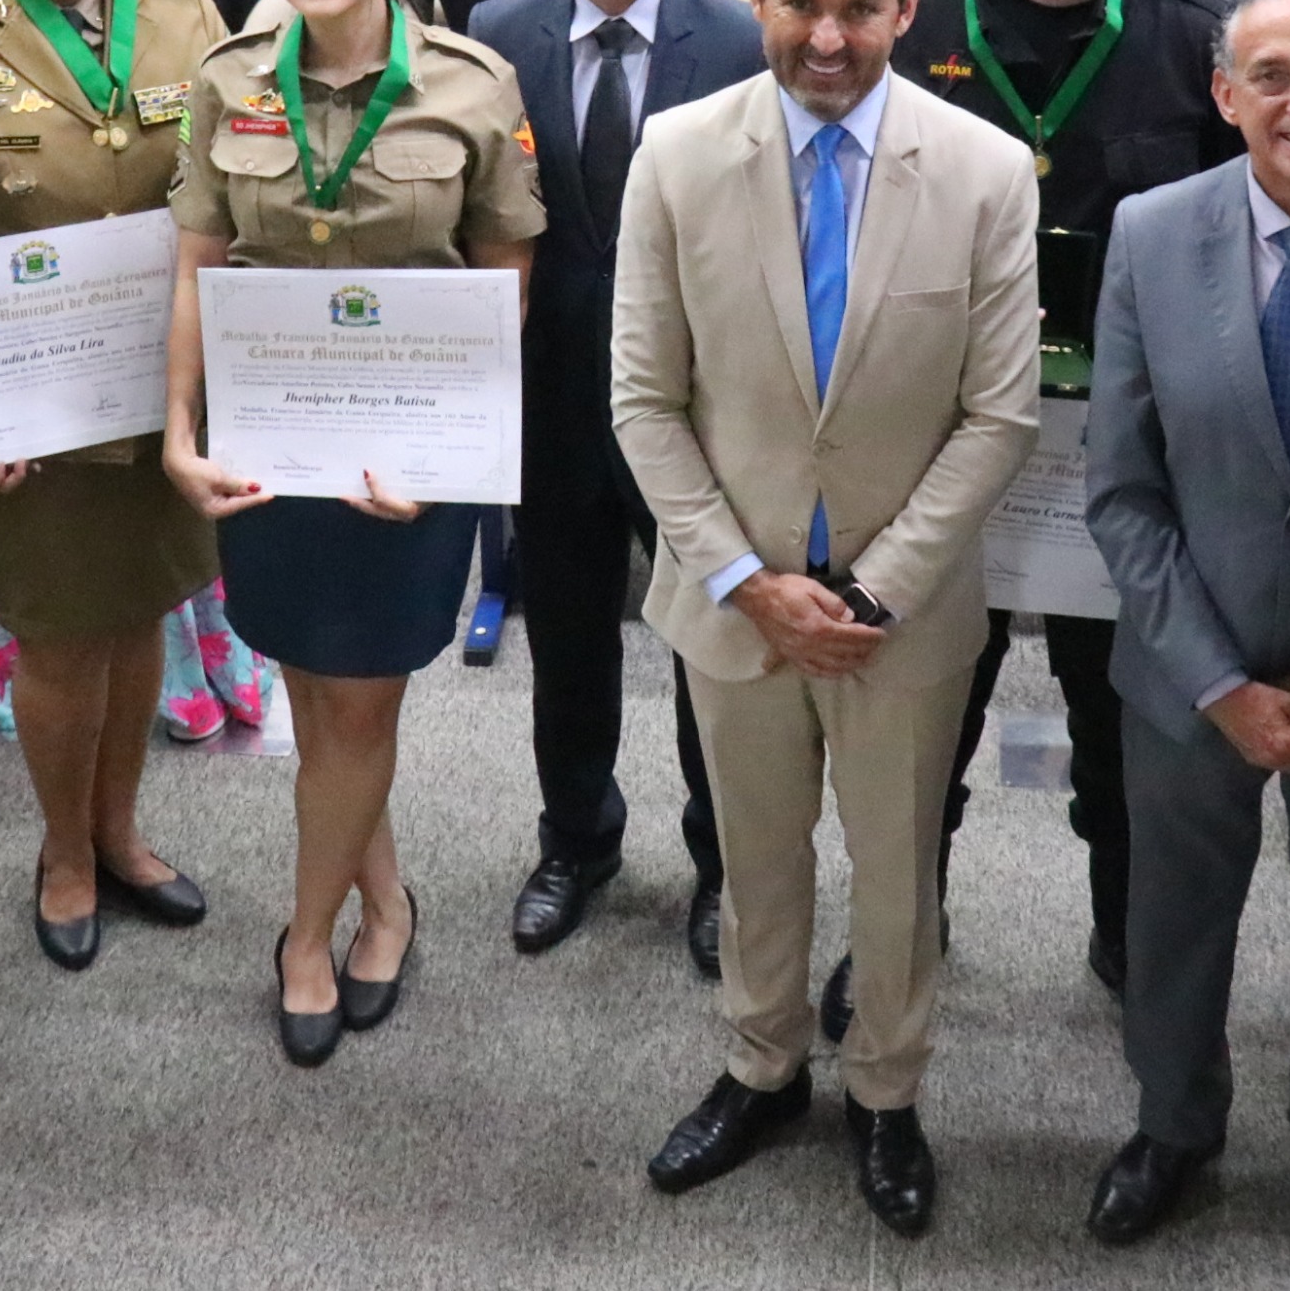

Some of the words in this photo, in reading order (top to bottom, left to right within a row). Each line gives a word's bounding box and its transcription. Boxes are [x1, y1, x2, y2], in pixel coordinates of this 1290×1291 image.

[930, 64, 972, 77] ROTAM
[69, 296, 83, 309] de
[88, 285, 143, 306] Goiânia
[30, 348, 45, 361] da
[47, 342, 77, 358] Silva
[80, 337, 106, 352] Lira
[247, 344, 306, 361] Câmara
[309, 346, 385, 363] Municipal
[388, 347, 404, 362] de
[408, 346, 469, 364] Goiânia
[282, 391, 345, 406] Jhenipher
[348, 393, 390, 407] Borges
[393, 394, 437, 407] Batista
[1002, 502, 1041, 516] Lauro
